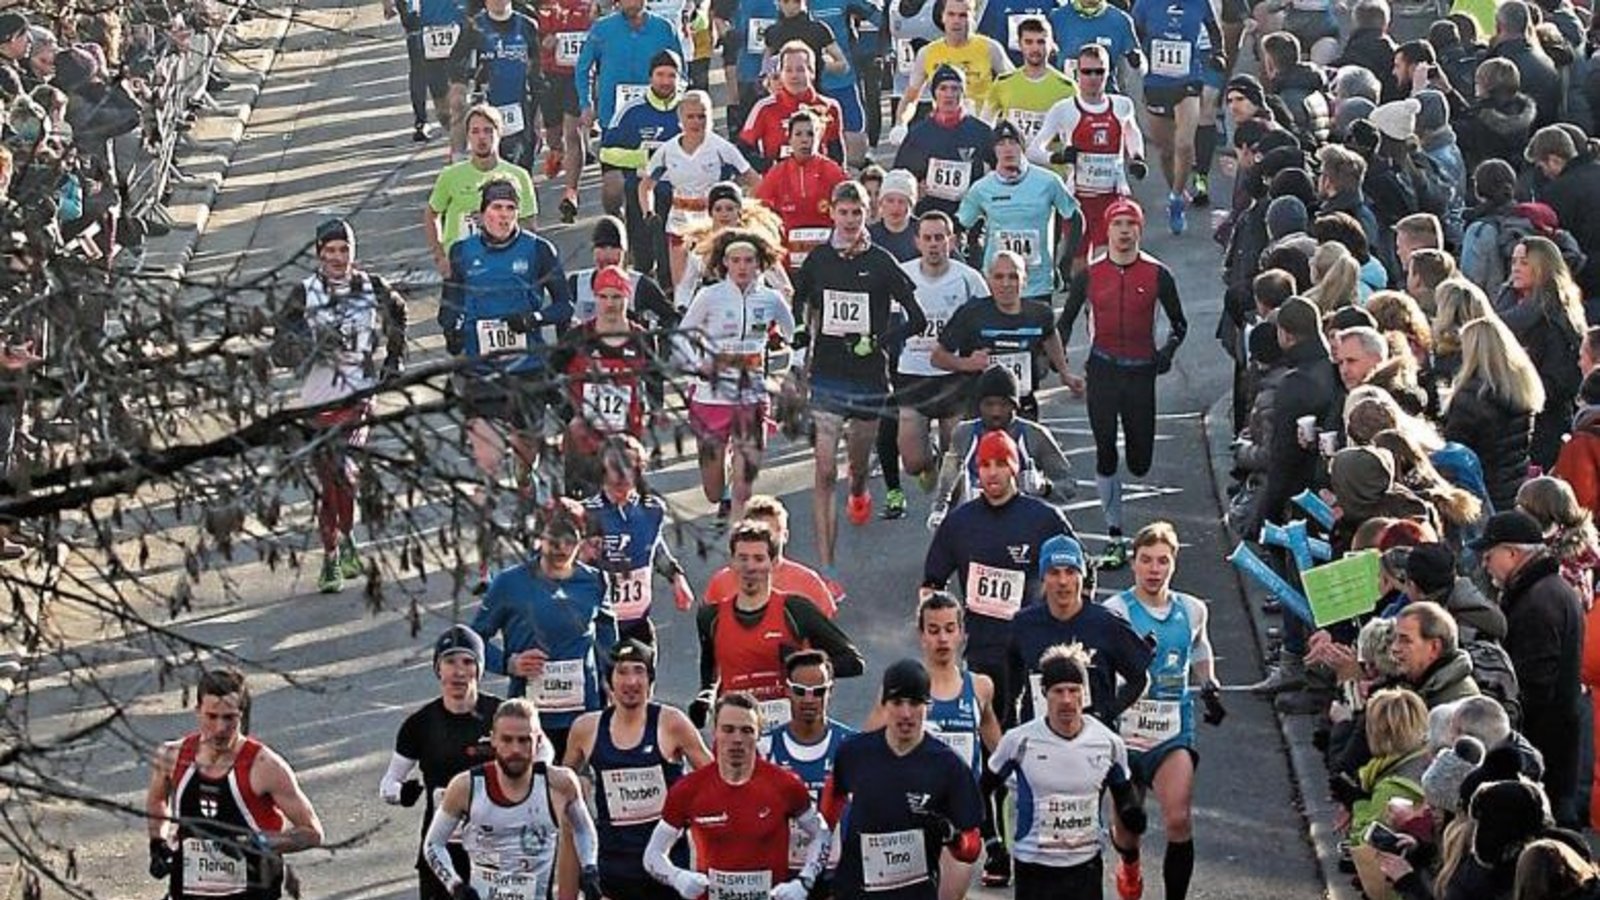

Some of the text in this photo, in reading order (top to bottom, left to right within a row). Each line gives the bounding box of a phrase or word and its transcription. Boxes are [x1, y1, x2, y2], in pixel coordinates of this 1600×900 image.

[431, 32, 453, 46] 129
[1159, 48, 1181, 64] 111
[935, 167, 962, 187] 618
[831, 301, 860, 321] 102
[610, 581, 642, 604] 613
[978, 576, 1011, 601] 610
[1138, 716, 1170, 732] Marcel
[619, 786, 661, 801] Thorben
[1053, 815, 1092, 830] Andreas
[198, 856, 236, 874] Florian
[883, 851, 911, 866] Timo
[717, 887, 769, 900] Sebastian
